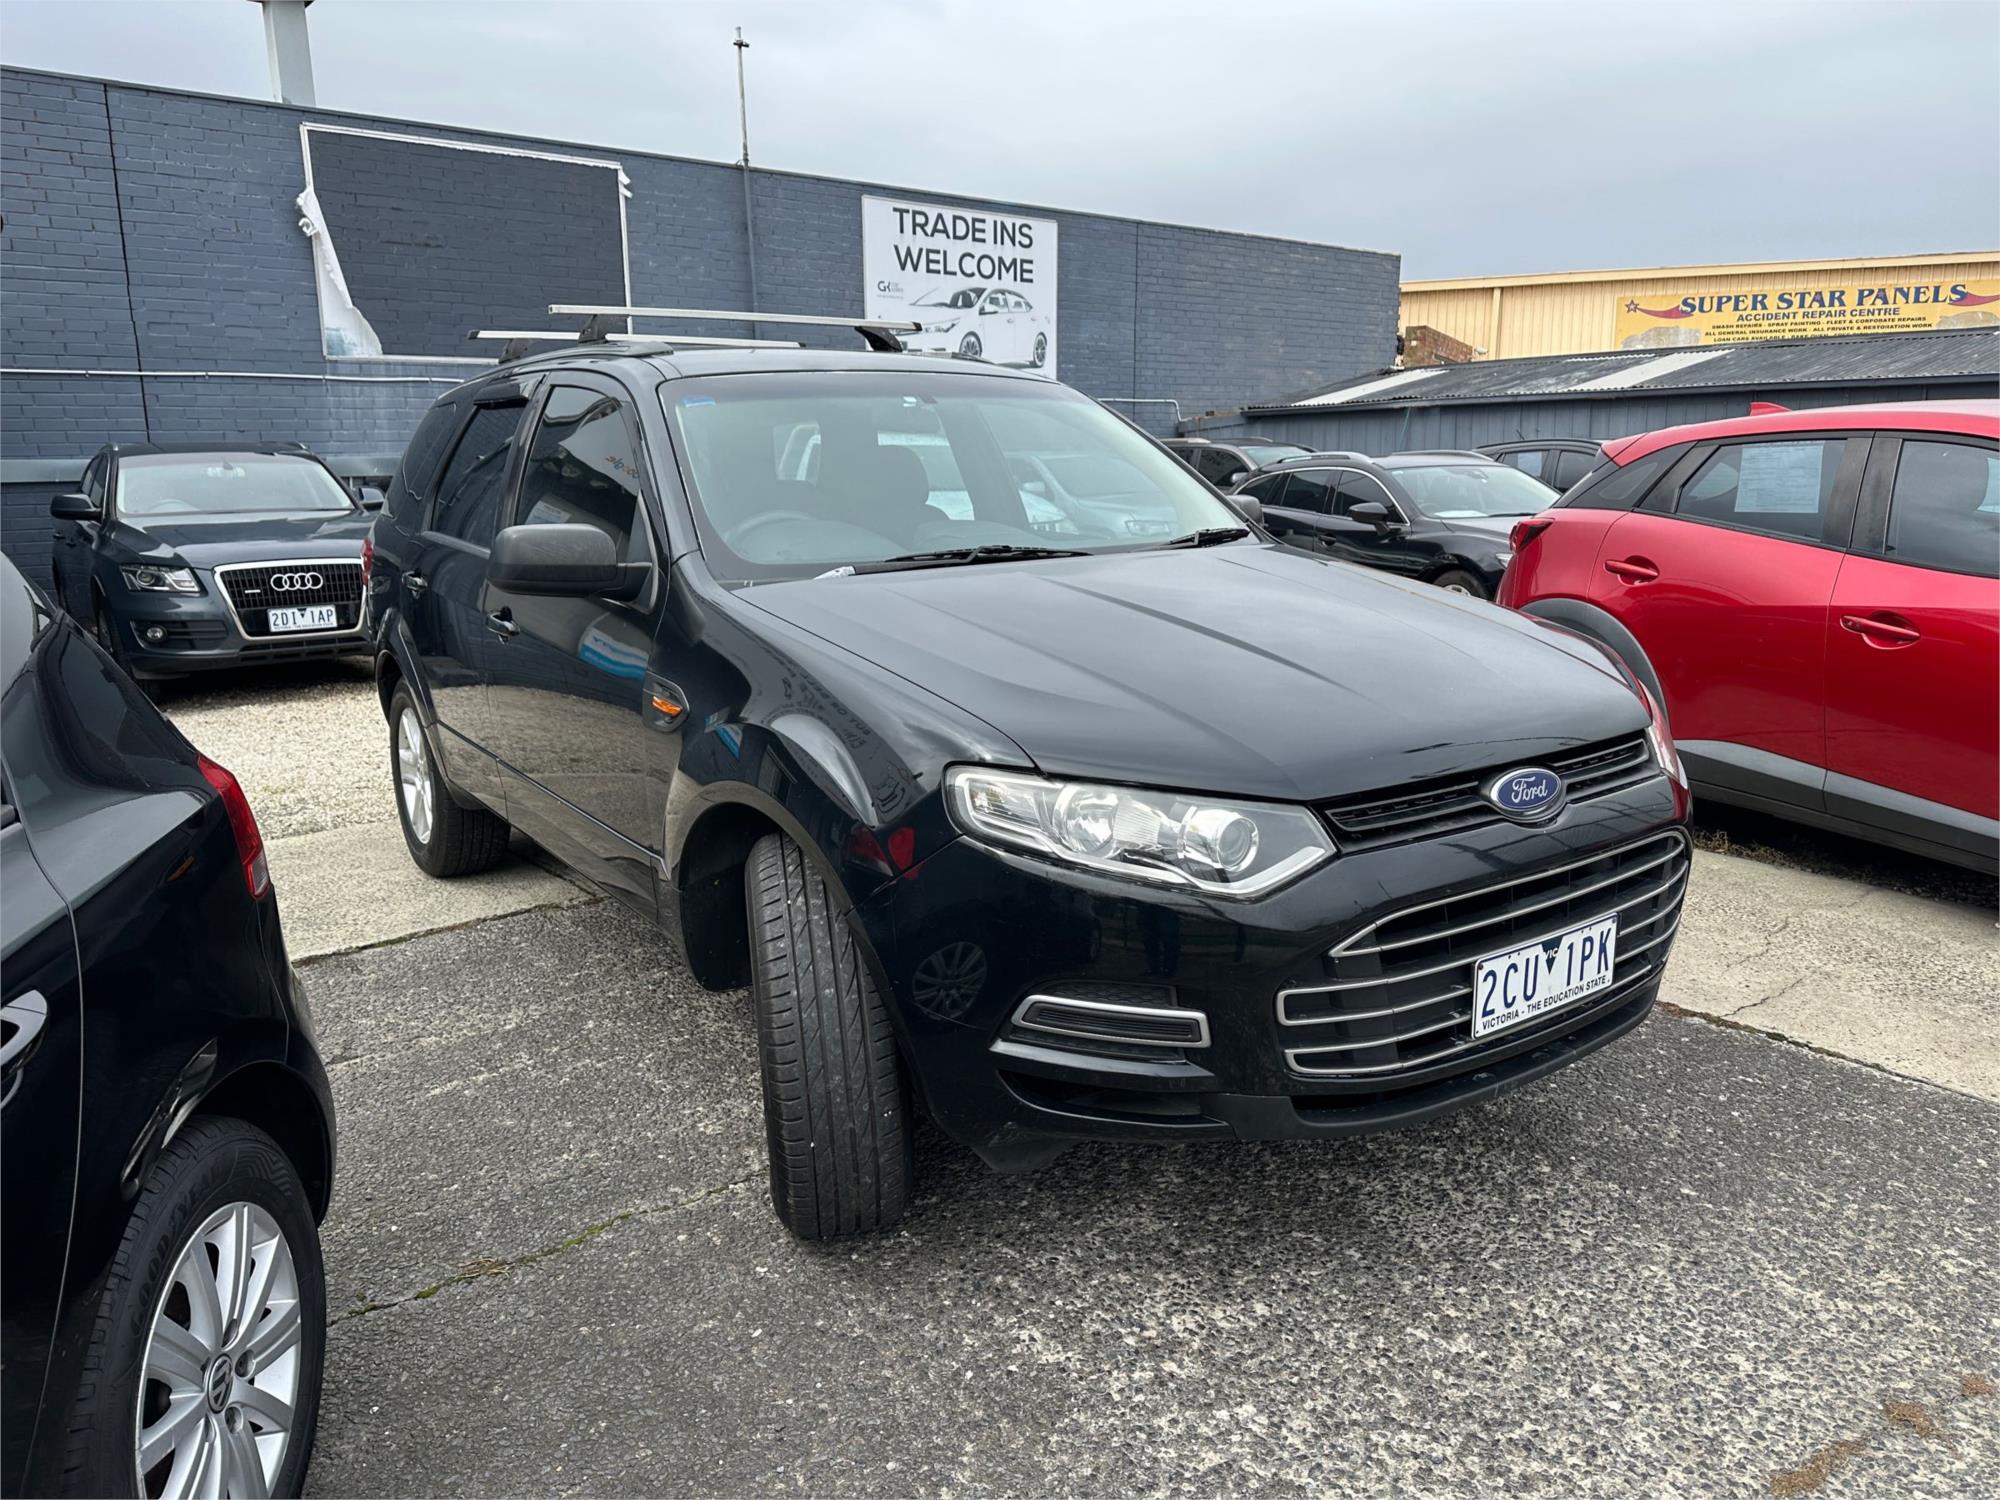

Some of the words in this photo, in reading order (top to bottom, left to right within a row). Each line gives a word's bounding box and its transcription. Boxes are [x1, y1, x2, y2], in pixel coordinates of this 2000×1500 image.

[892, 207, 987, 244] TRADE
[993, 219, 1034, 249] INS
[893, 244, 1034, 284] WELCOME
[1680, 293, 1769, 314] SUPER
[1776, 289, 1847, 310] STAR
[1856, 283, 1969, 307] PANELS
[1736, 311, 1799, 323] ACCIDENT
[1802, 309, 1847, 320] REPAIR
[1849, 307, 1901, 318] CENTRE
[1510, 775, 1549, 804] Ford
[1481, 954, 1540, 1019] 2CU
[1566, 927, 1612, 988] 1PK
[1481, 1009, 1520, 1031] VICTORIA
[1526, 1000, 1542, 1014] THE
[1543, 985, 1584, 1008] EDUCATION
[1586, 974, 1607, 991] STATE
